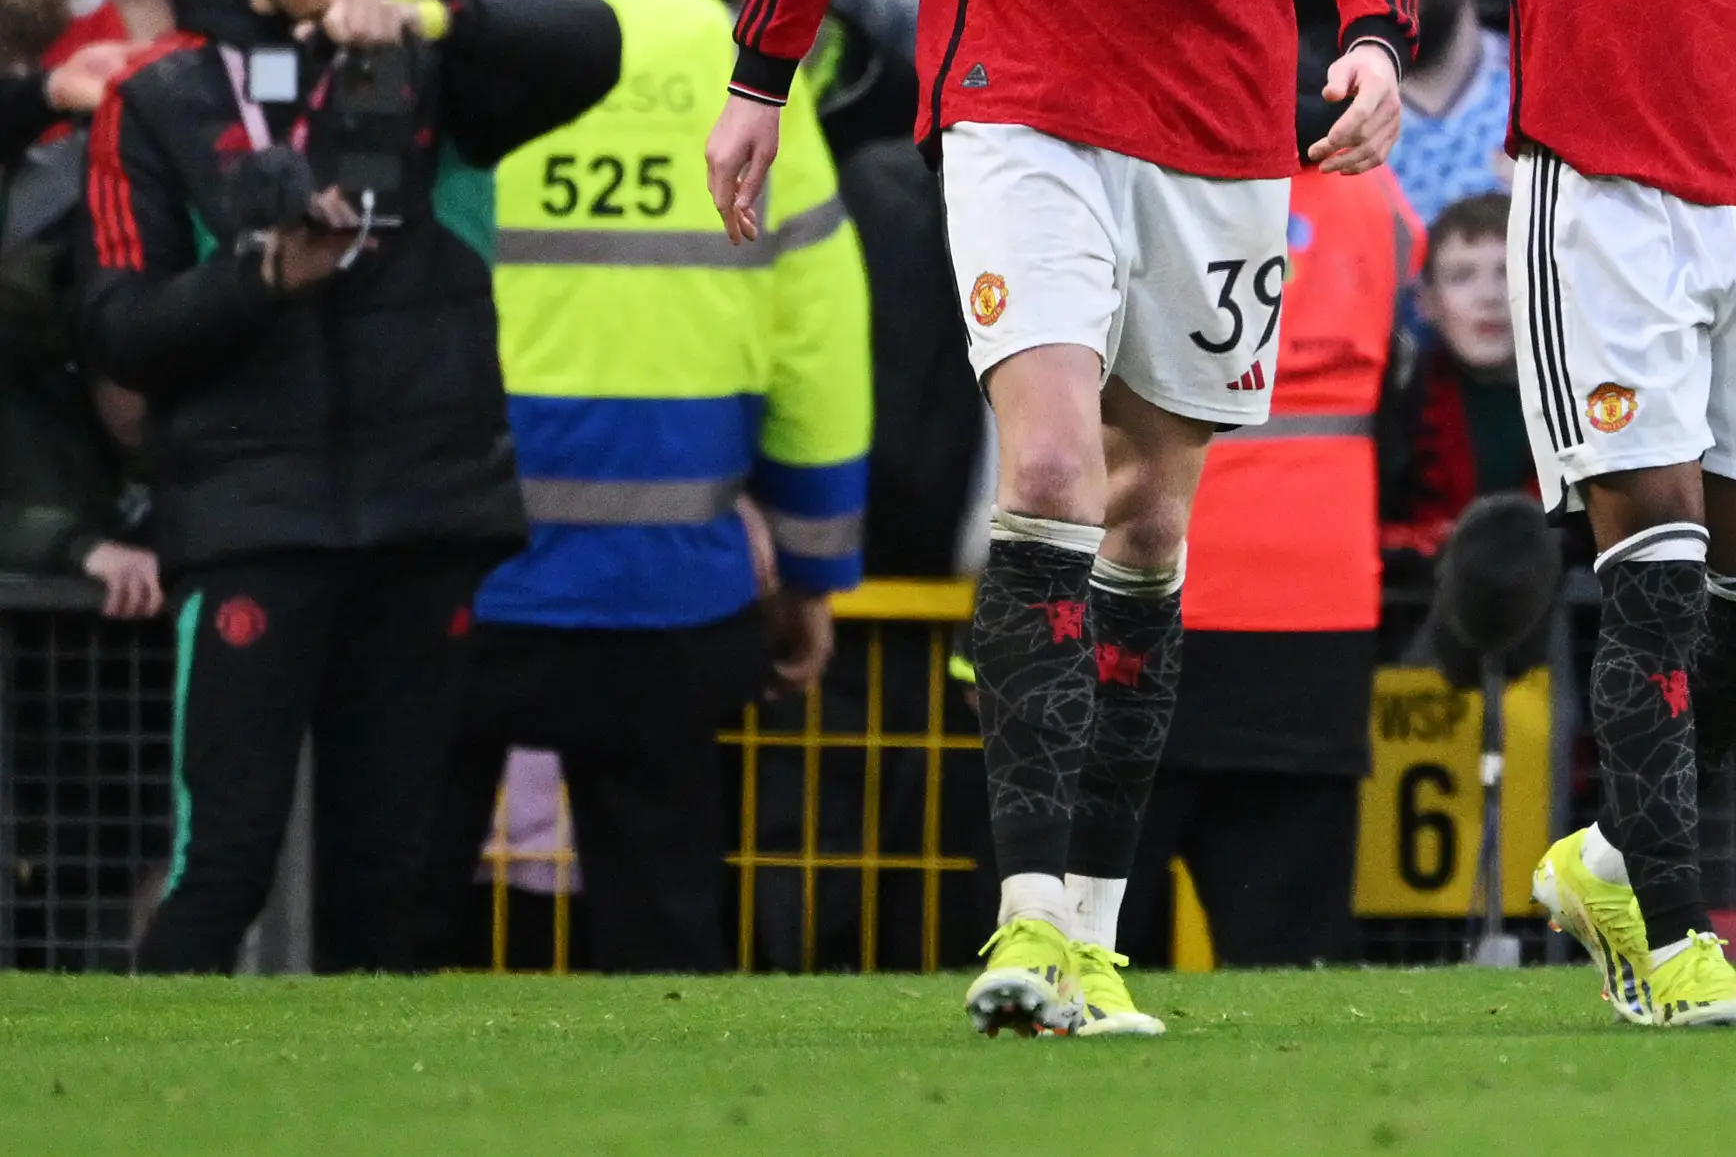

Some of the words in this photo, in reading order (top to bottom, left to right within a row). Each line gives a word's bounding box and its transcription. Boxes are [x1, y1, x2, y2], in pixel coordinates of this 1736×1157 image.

[541, 153, 675, 218] 525
[1188, 254, 1286, 357] 39
[1398, 762, 1458, 892] 6
